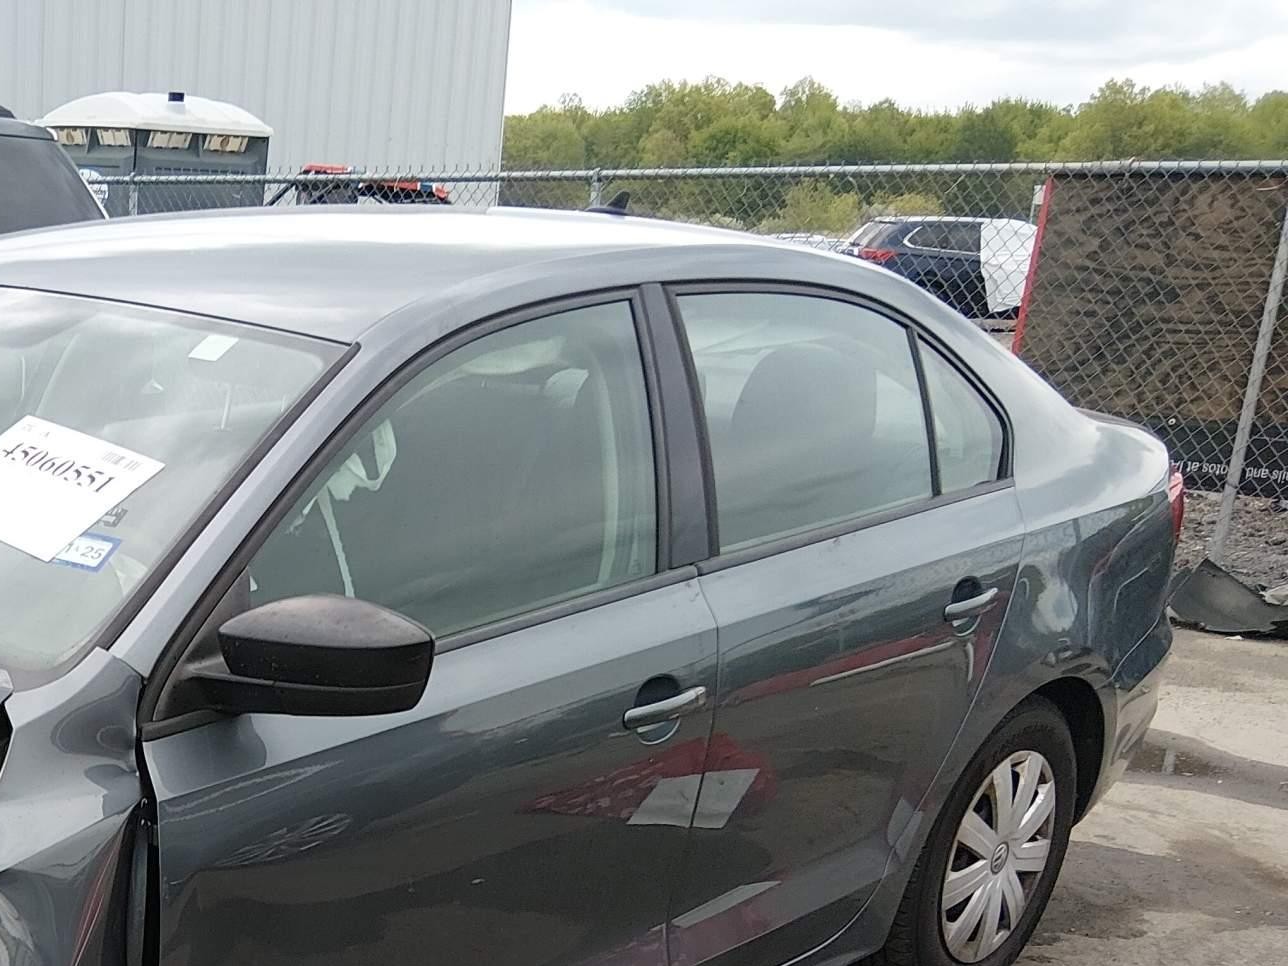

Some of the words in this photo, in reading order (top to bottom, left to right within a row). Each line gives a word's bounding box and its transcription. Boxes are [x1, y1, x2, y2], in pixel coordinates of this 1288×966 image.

[2, 442, 117, 493] 45060551
[1186, 461, 1200, 472] at
[1245, 467, 1269, 479] and
[79, 545, 106, 561] 25
